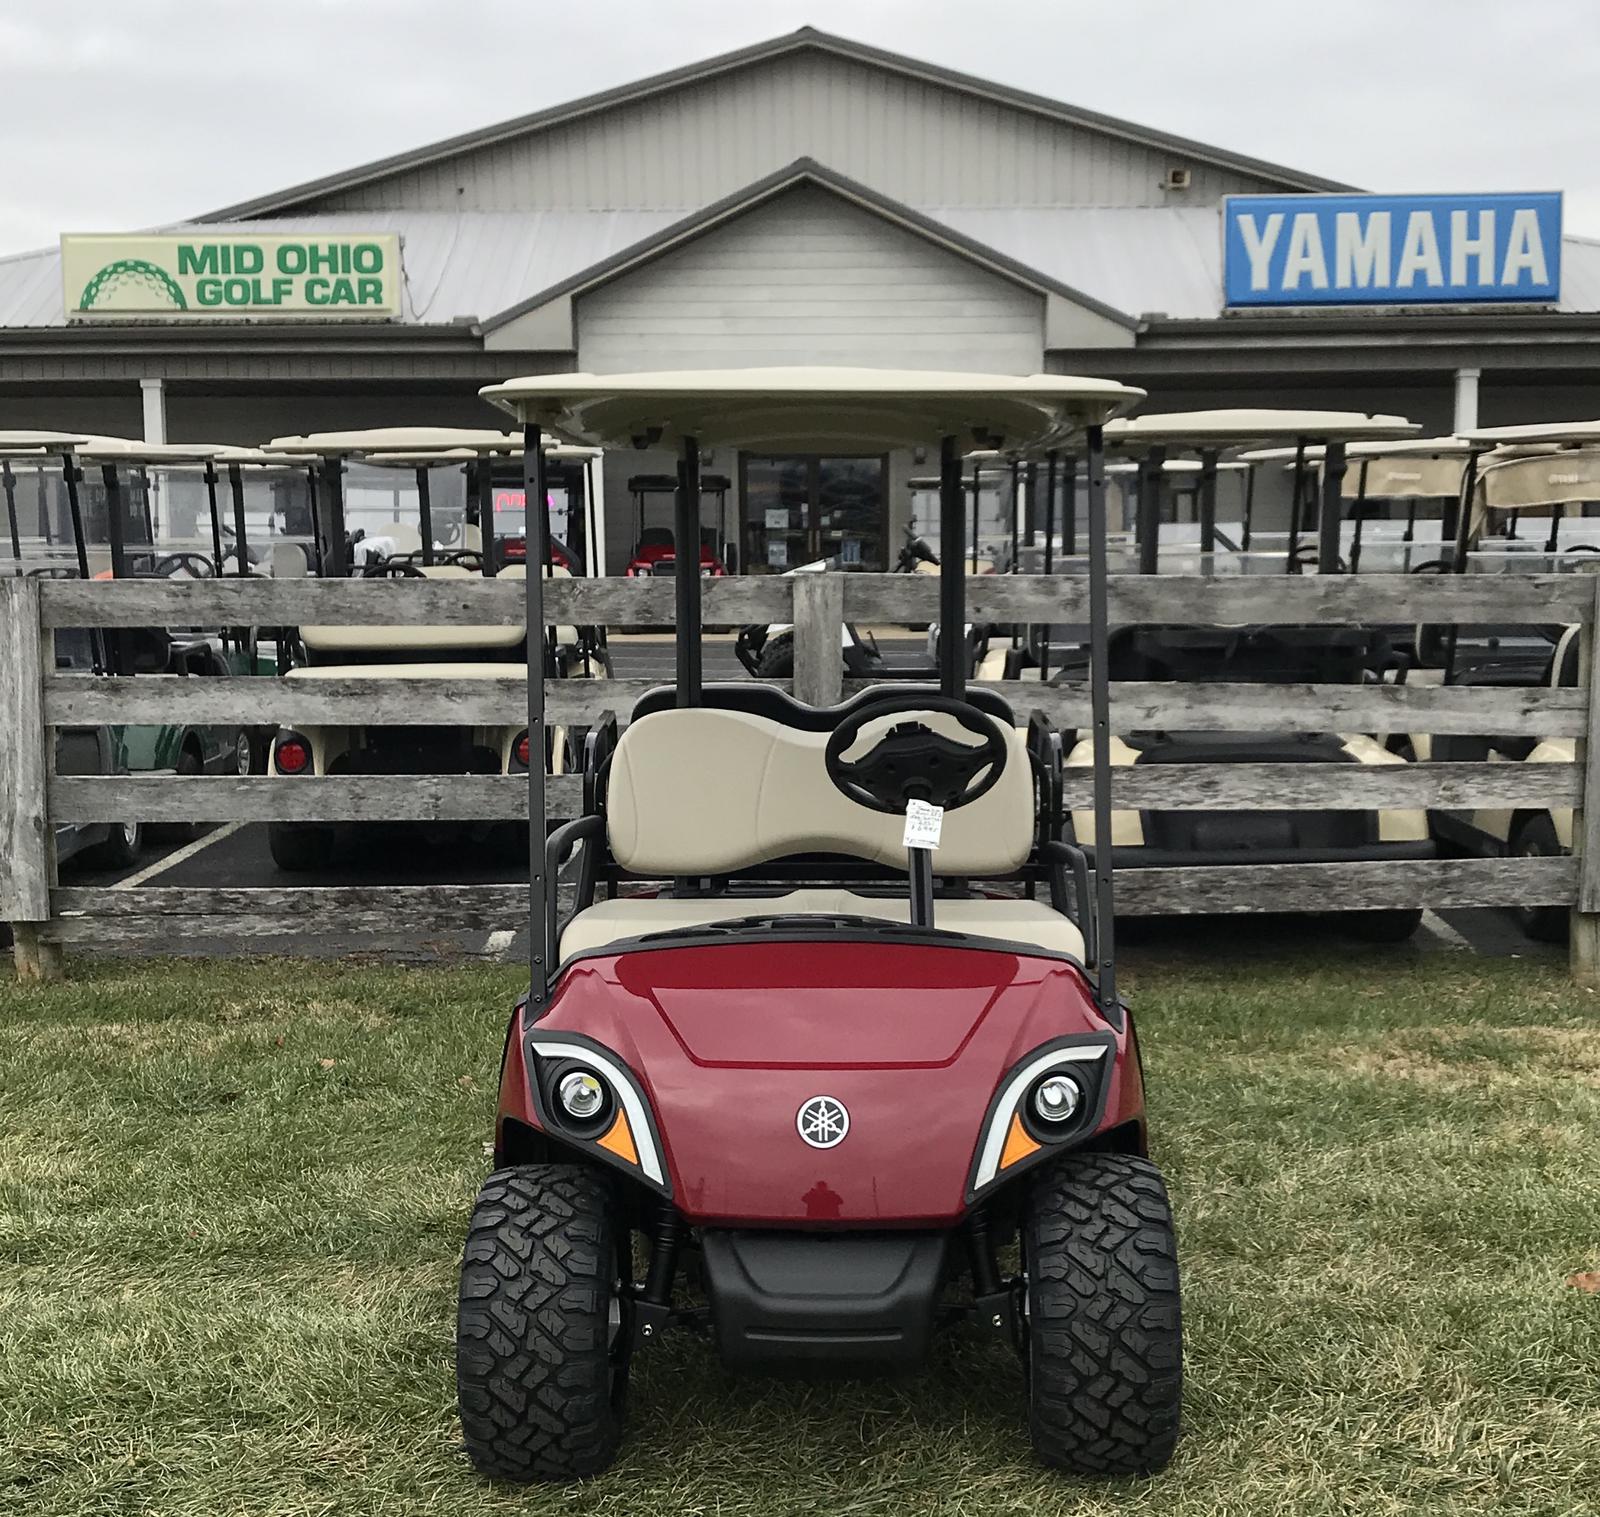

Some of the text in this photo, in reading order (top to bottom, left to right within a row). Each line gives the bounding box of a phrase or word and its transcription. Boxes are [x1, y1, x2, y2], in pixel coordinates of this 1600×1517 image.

[178, 244, 384, 275] MID OHIO
[1236, 208, 1549, 291] YAMAHA
[196, 278, 383, 305] GOLF CAR
